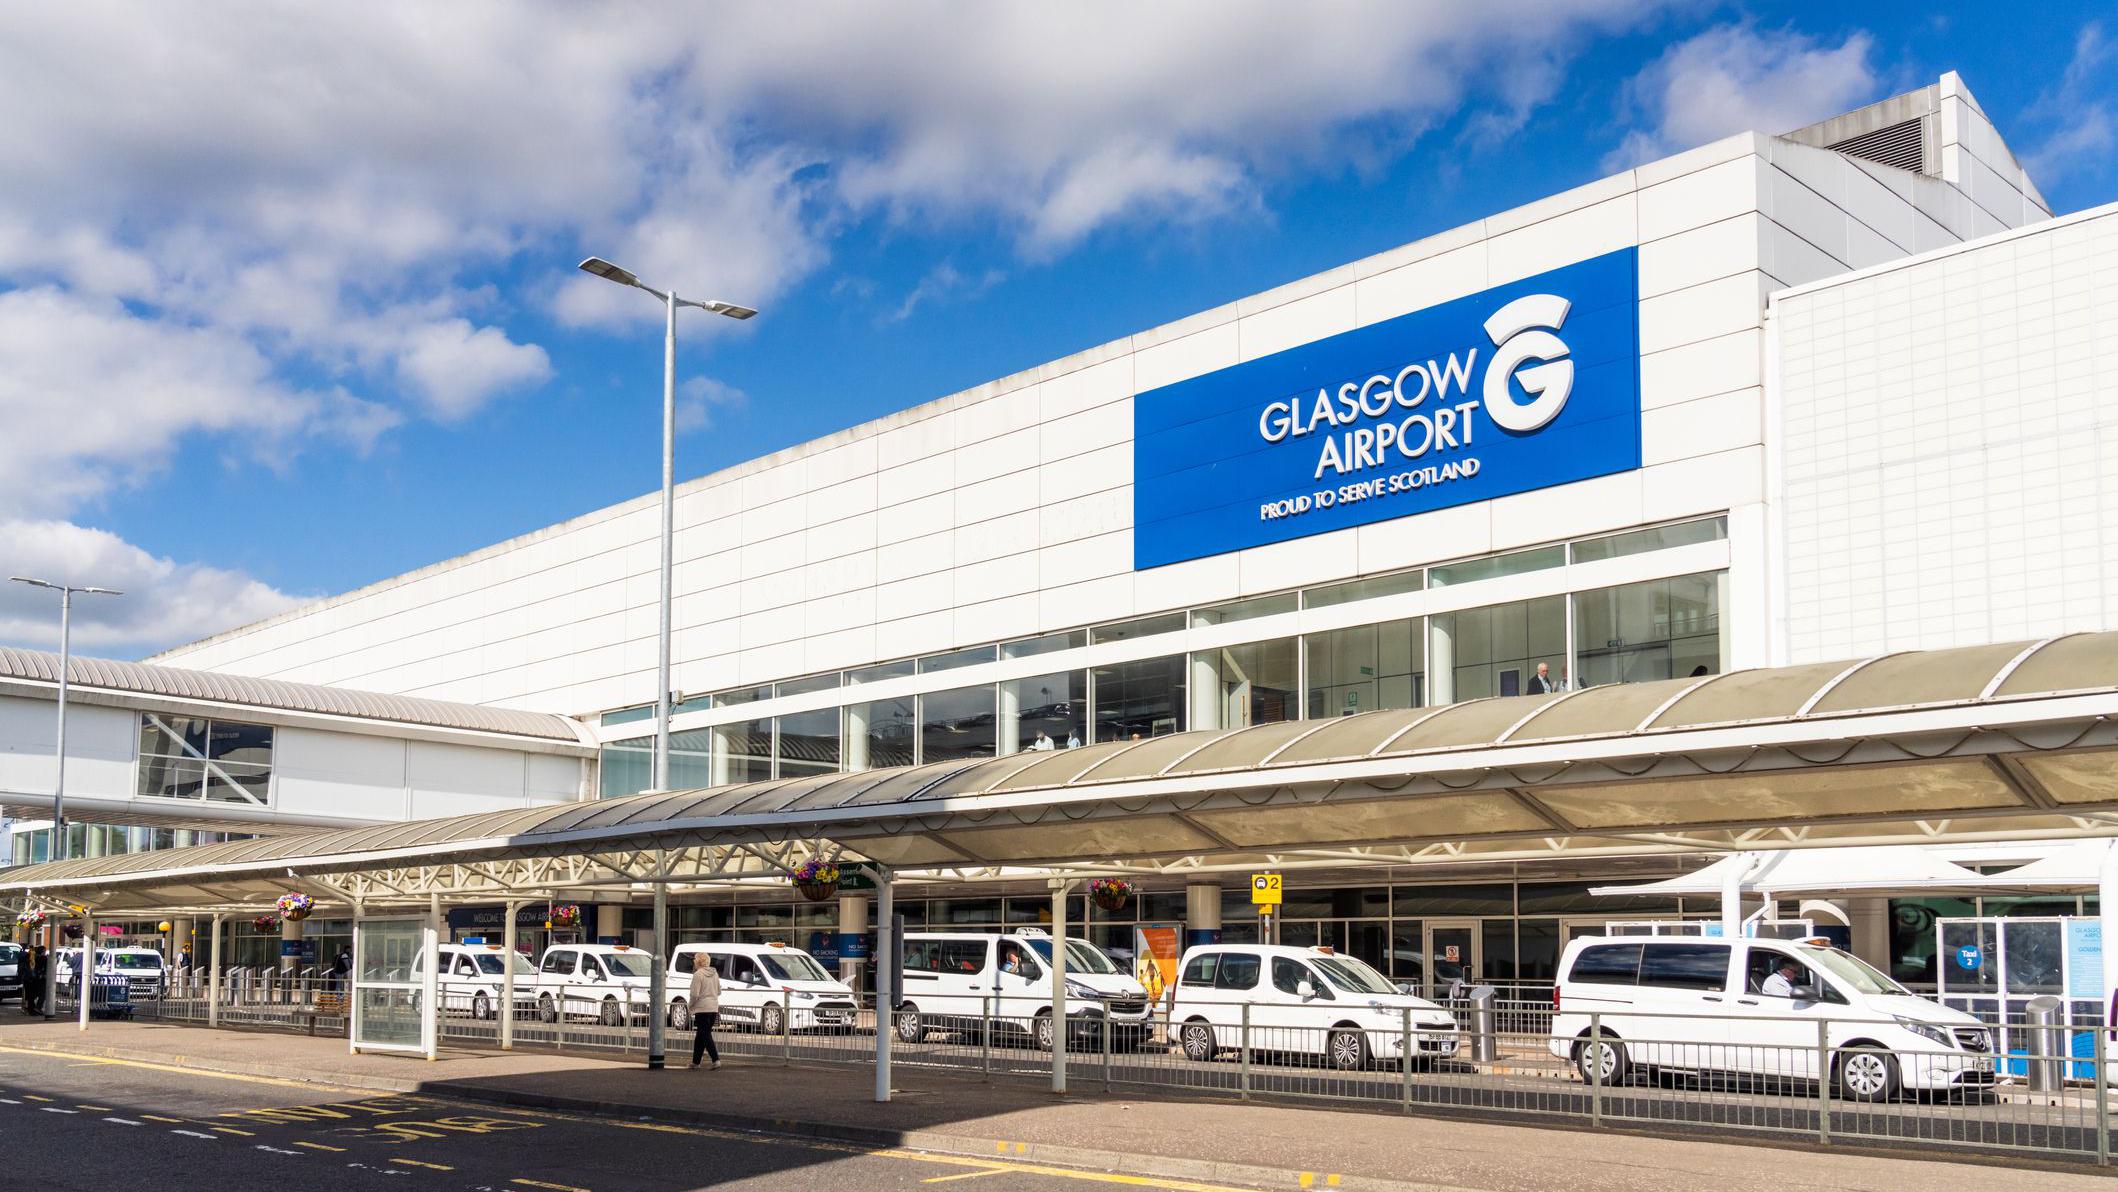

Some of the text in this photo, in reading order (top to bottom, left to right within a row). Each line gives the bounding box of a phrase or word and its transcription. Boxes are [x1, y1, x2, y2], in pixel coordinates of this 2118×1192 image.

[1259, 347, 1479, 443] GLASGOW
[1313, 400, 1480, 479] AIRPORT
[1260, 457, 1481, 521] PROUD TO SERVE SCOTLAND
[1270, 877, 1279, 890] 2
[1961, 949, 1977, 958] Taxi
[1967, 958, 1973, 966] 2
